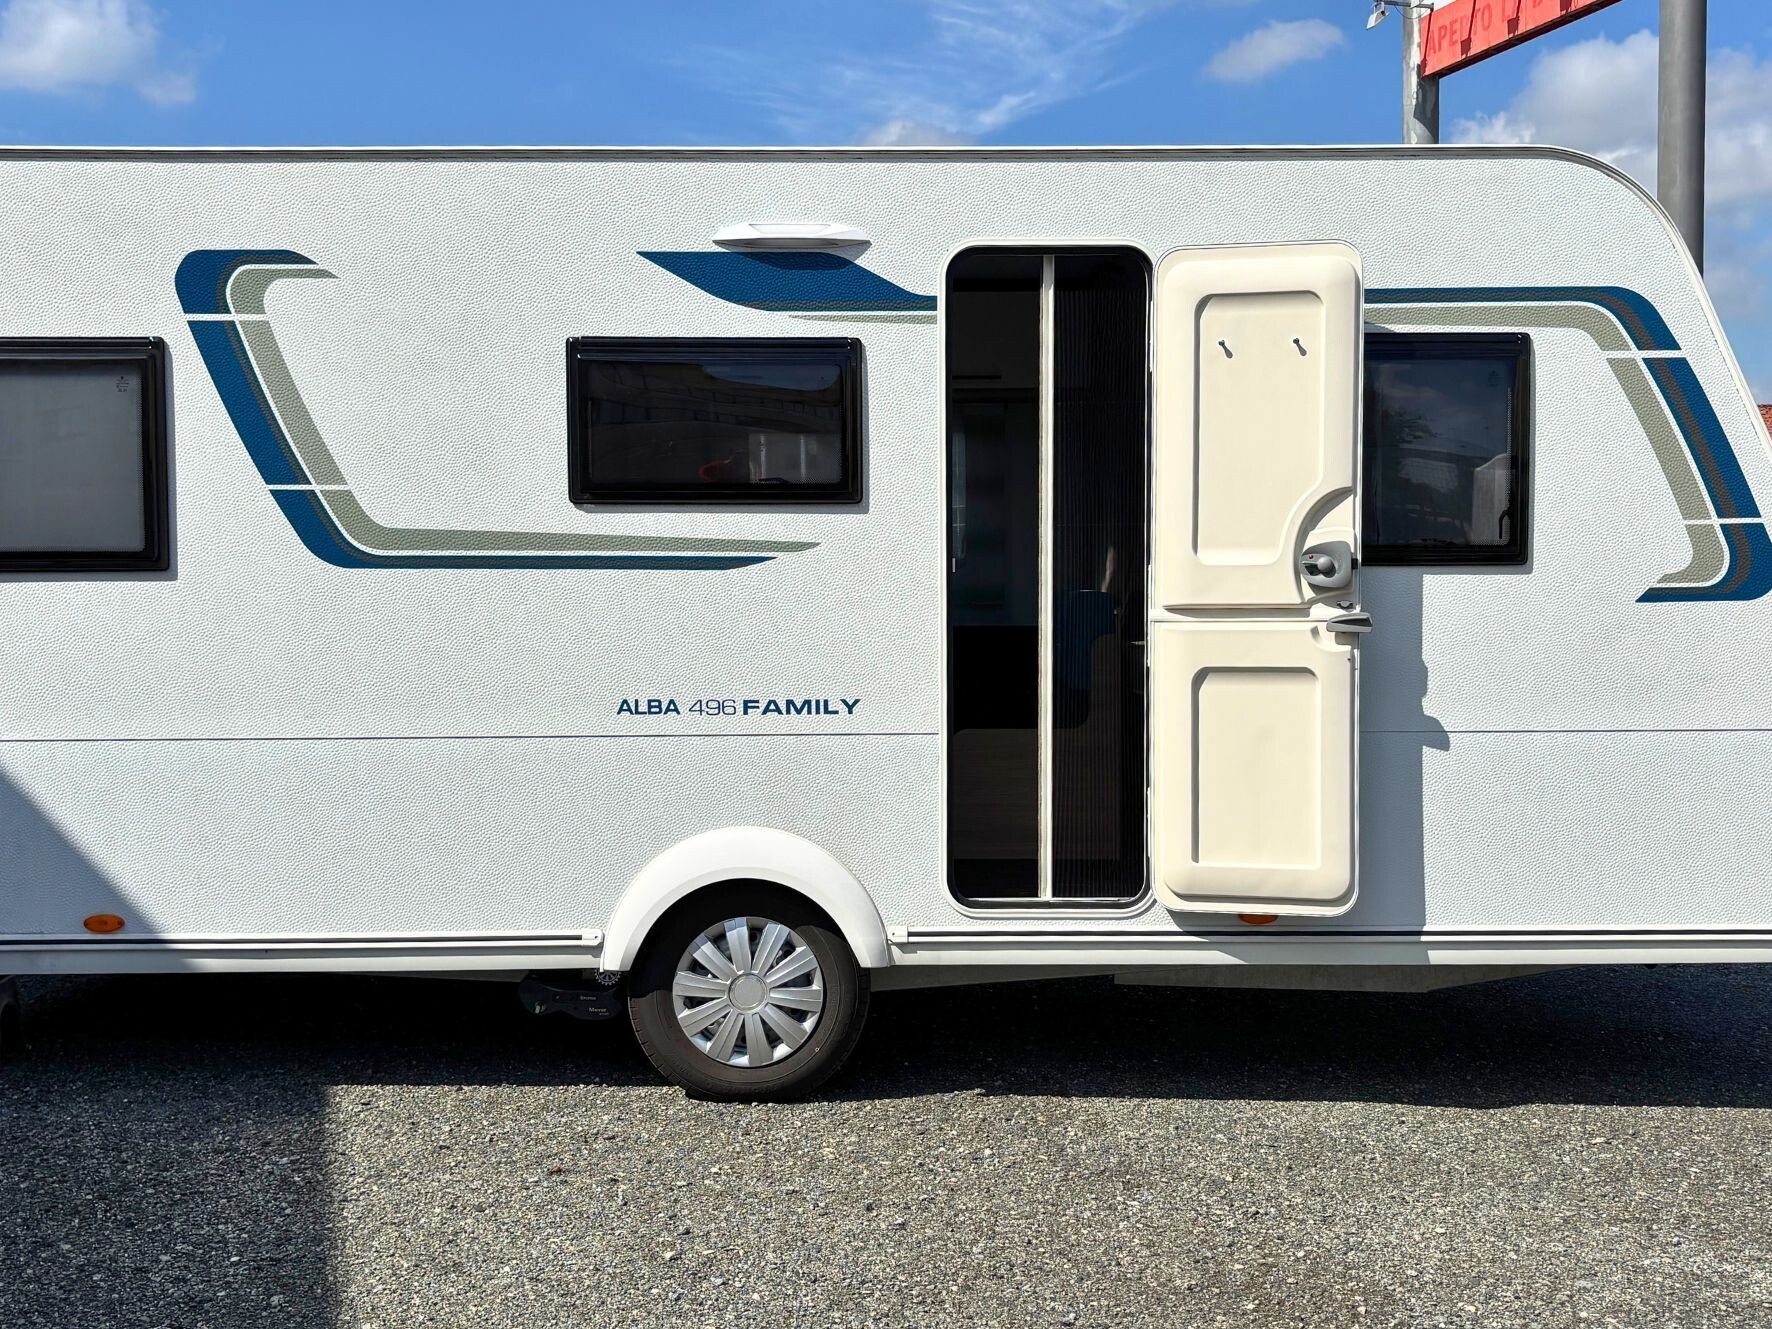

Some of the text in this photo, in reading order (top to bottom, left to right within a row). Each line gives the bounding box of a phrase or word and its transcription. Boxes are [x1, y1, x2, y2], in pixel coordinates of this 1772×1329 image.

[616, 698, 862, 716] ALBA 496 FAMILY
